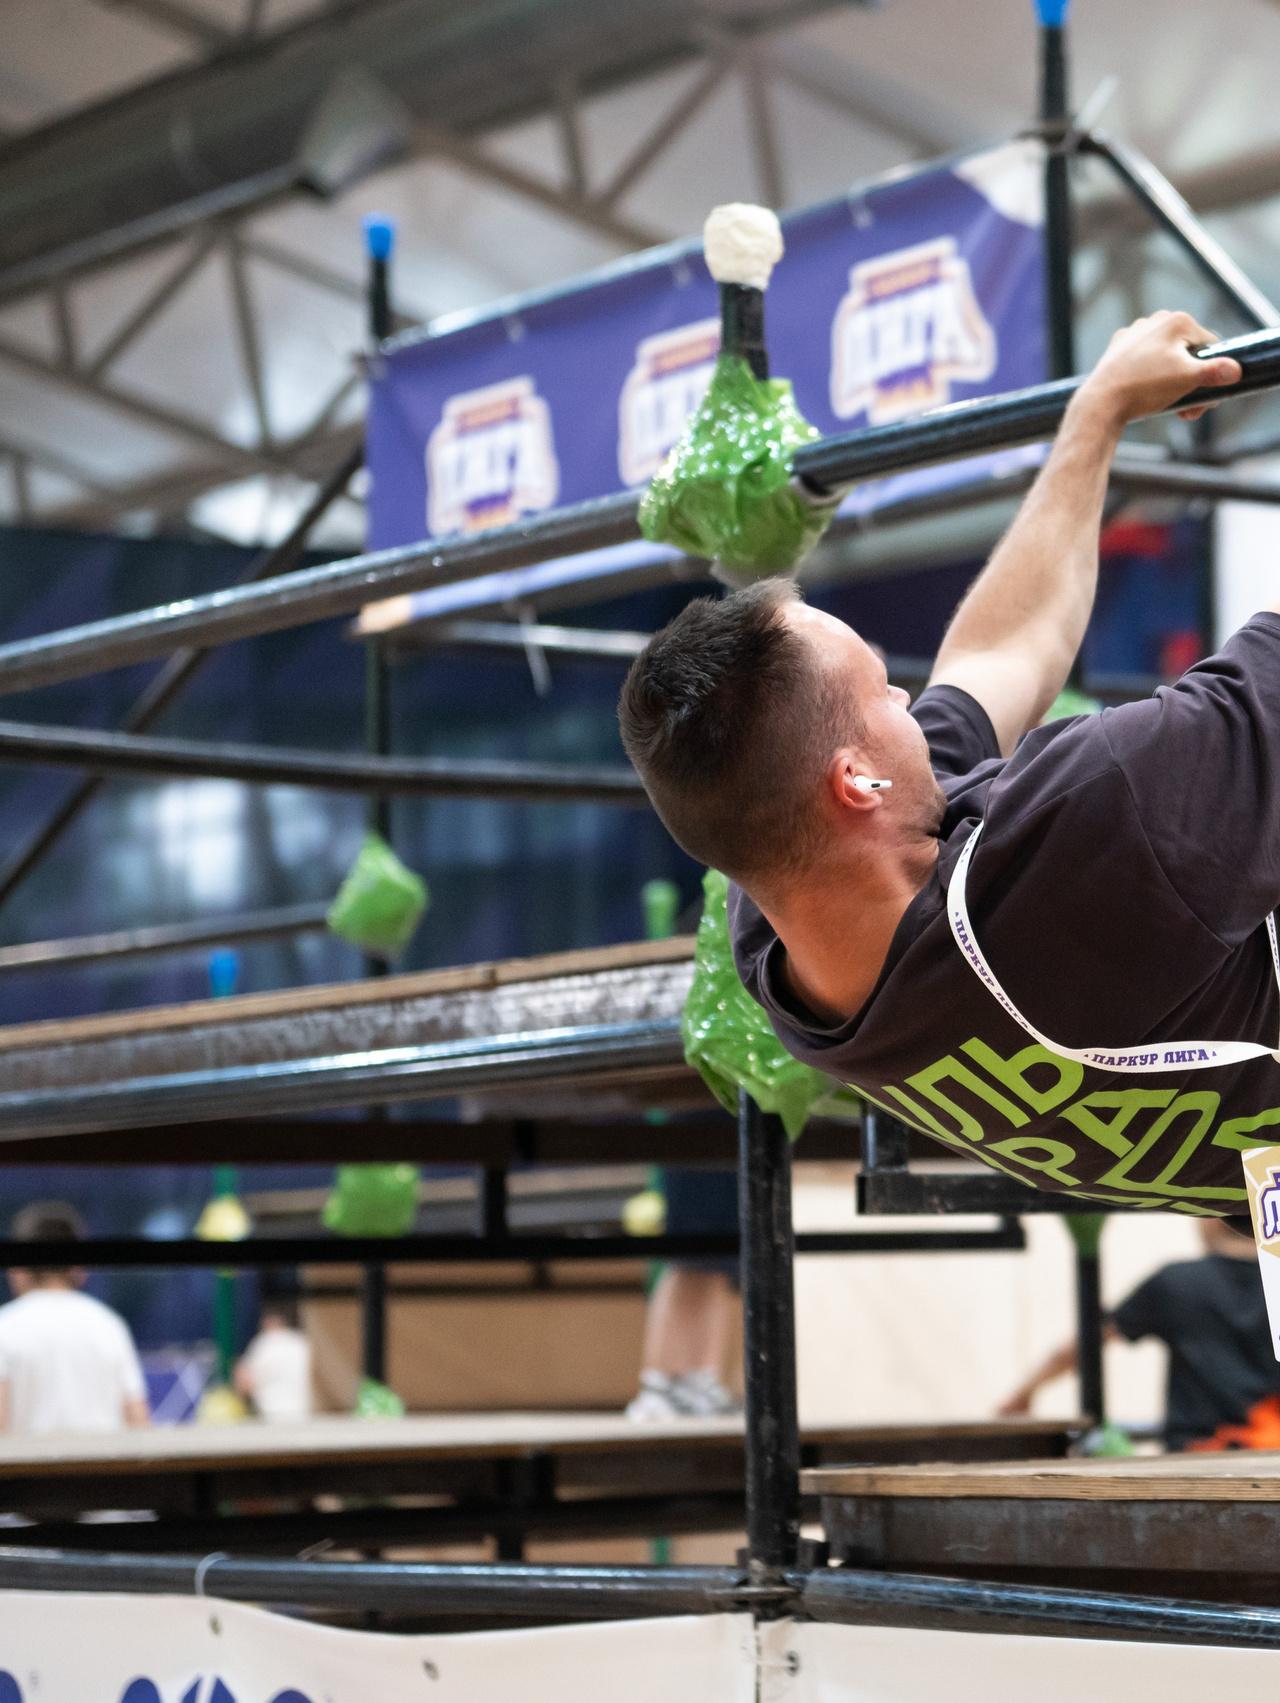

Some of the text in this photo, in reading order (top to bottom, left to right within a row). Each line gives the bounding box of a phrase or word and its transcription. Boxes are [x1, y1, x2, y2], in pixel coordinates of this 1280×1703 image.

[954, 919, 1029, 1030] ПАРКУР ЛИГА
[1091, 1048, 1210, 1067] ПАРКУР ЛИГА
